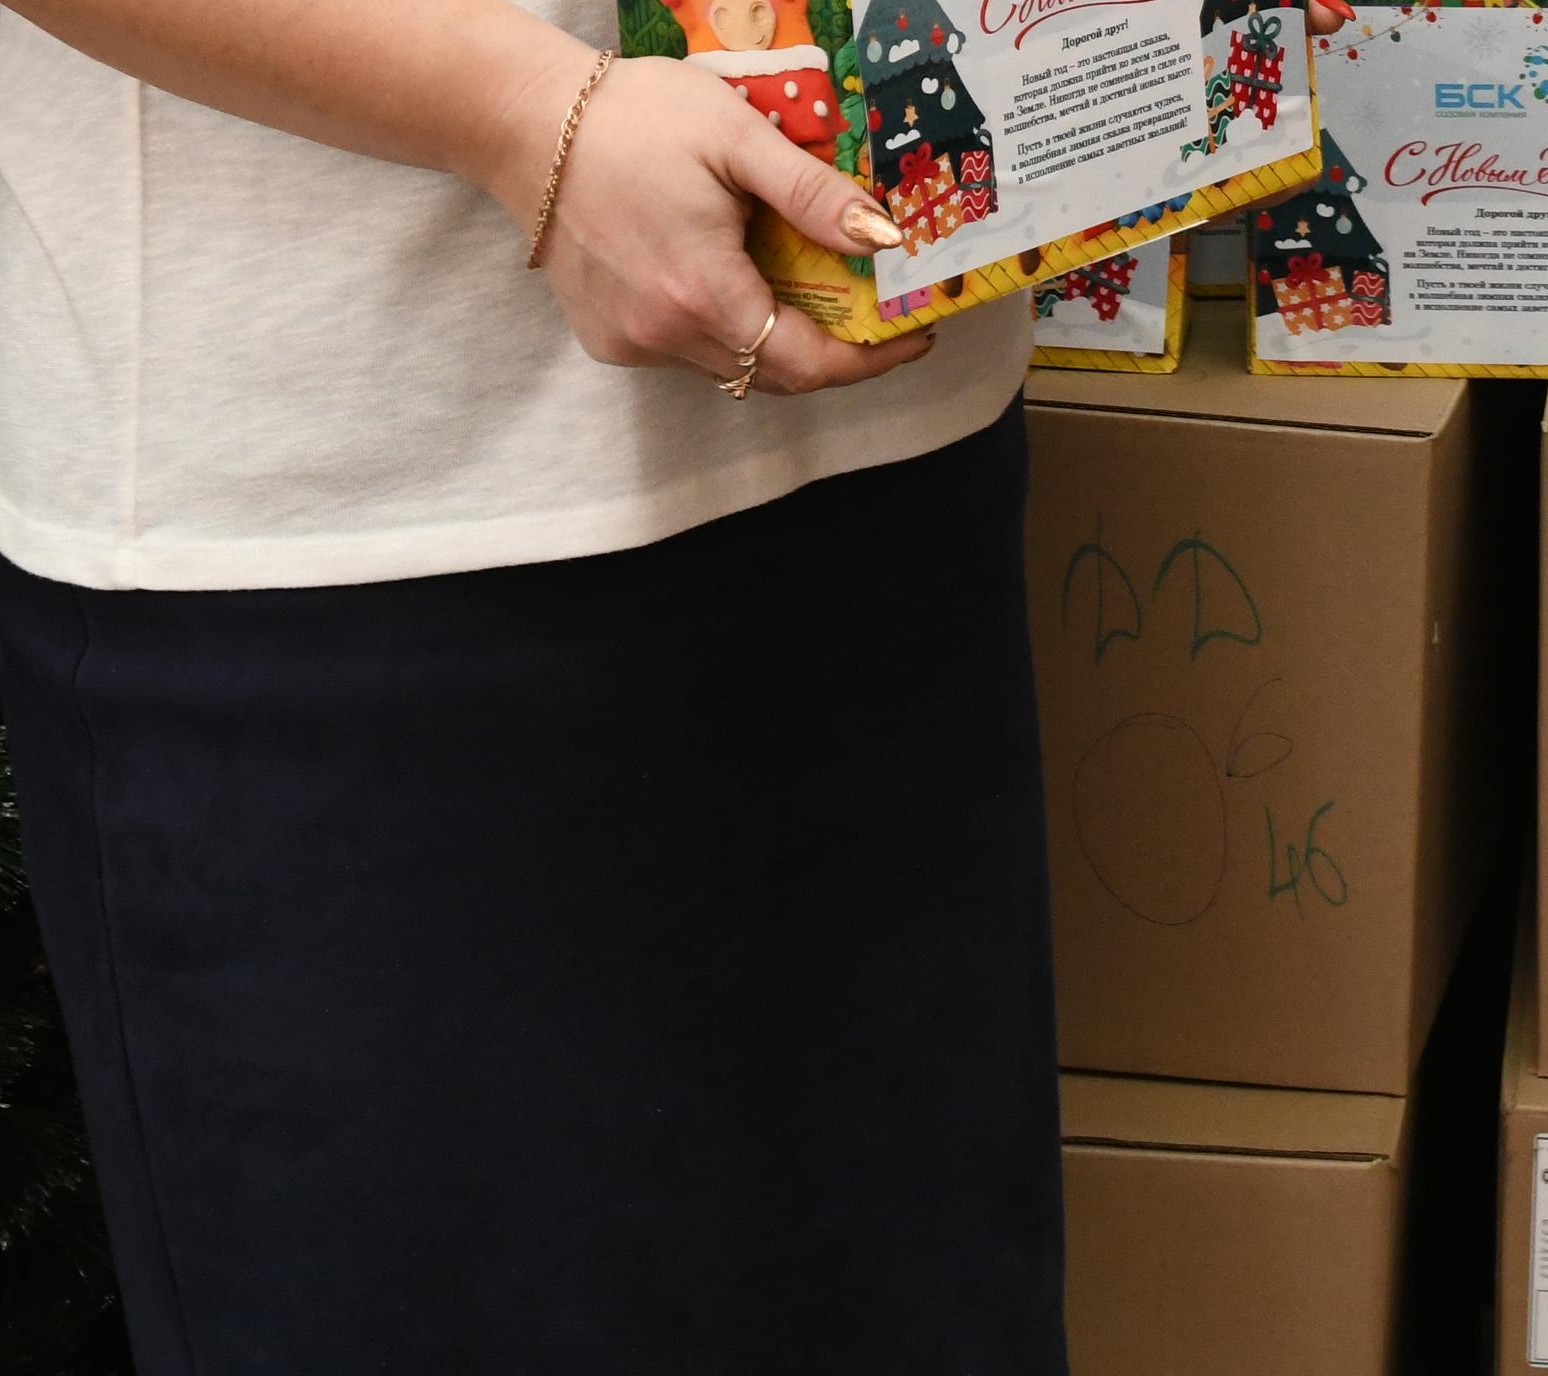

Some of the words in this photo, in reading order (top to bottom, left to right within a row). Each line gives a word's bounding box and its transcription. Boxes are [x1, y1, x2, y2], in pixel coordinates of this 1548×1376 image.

[1062, 28, 1103, 51] Дорогой
[1104, 19, 1130, 37] друг!
[1435, 83, 1525, 110] БСК
[1384, 140, 1428, 187] С
[1427, 140, 1528, 186] Новым
